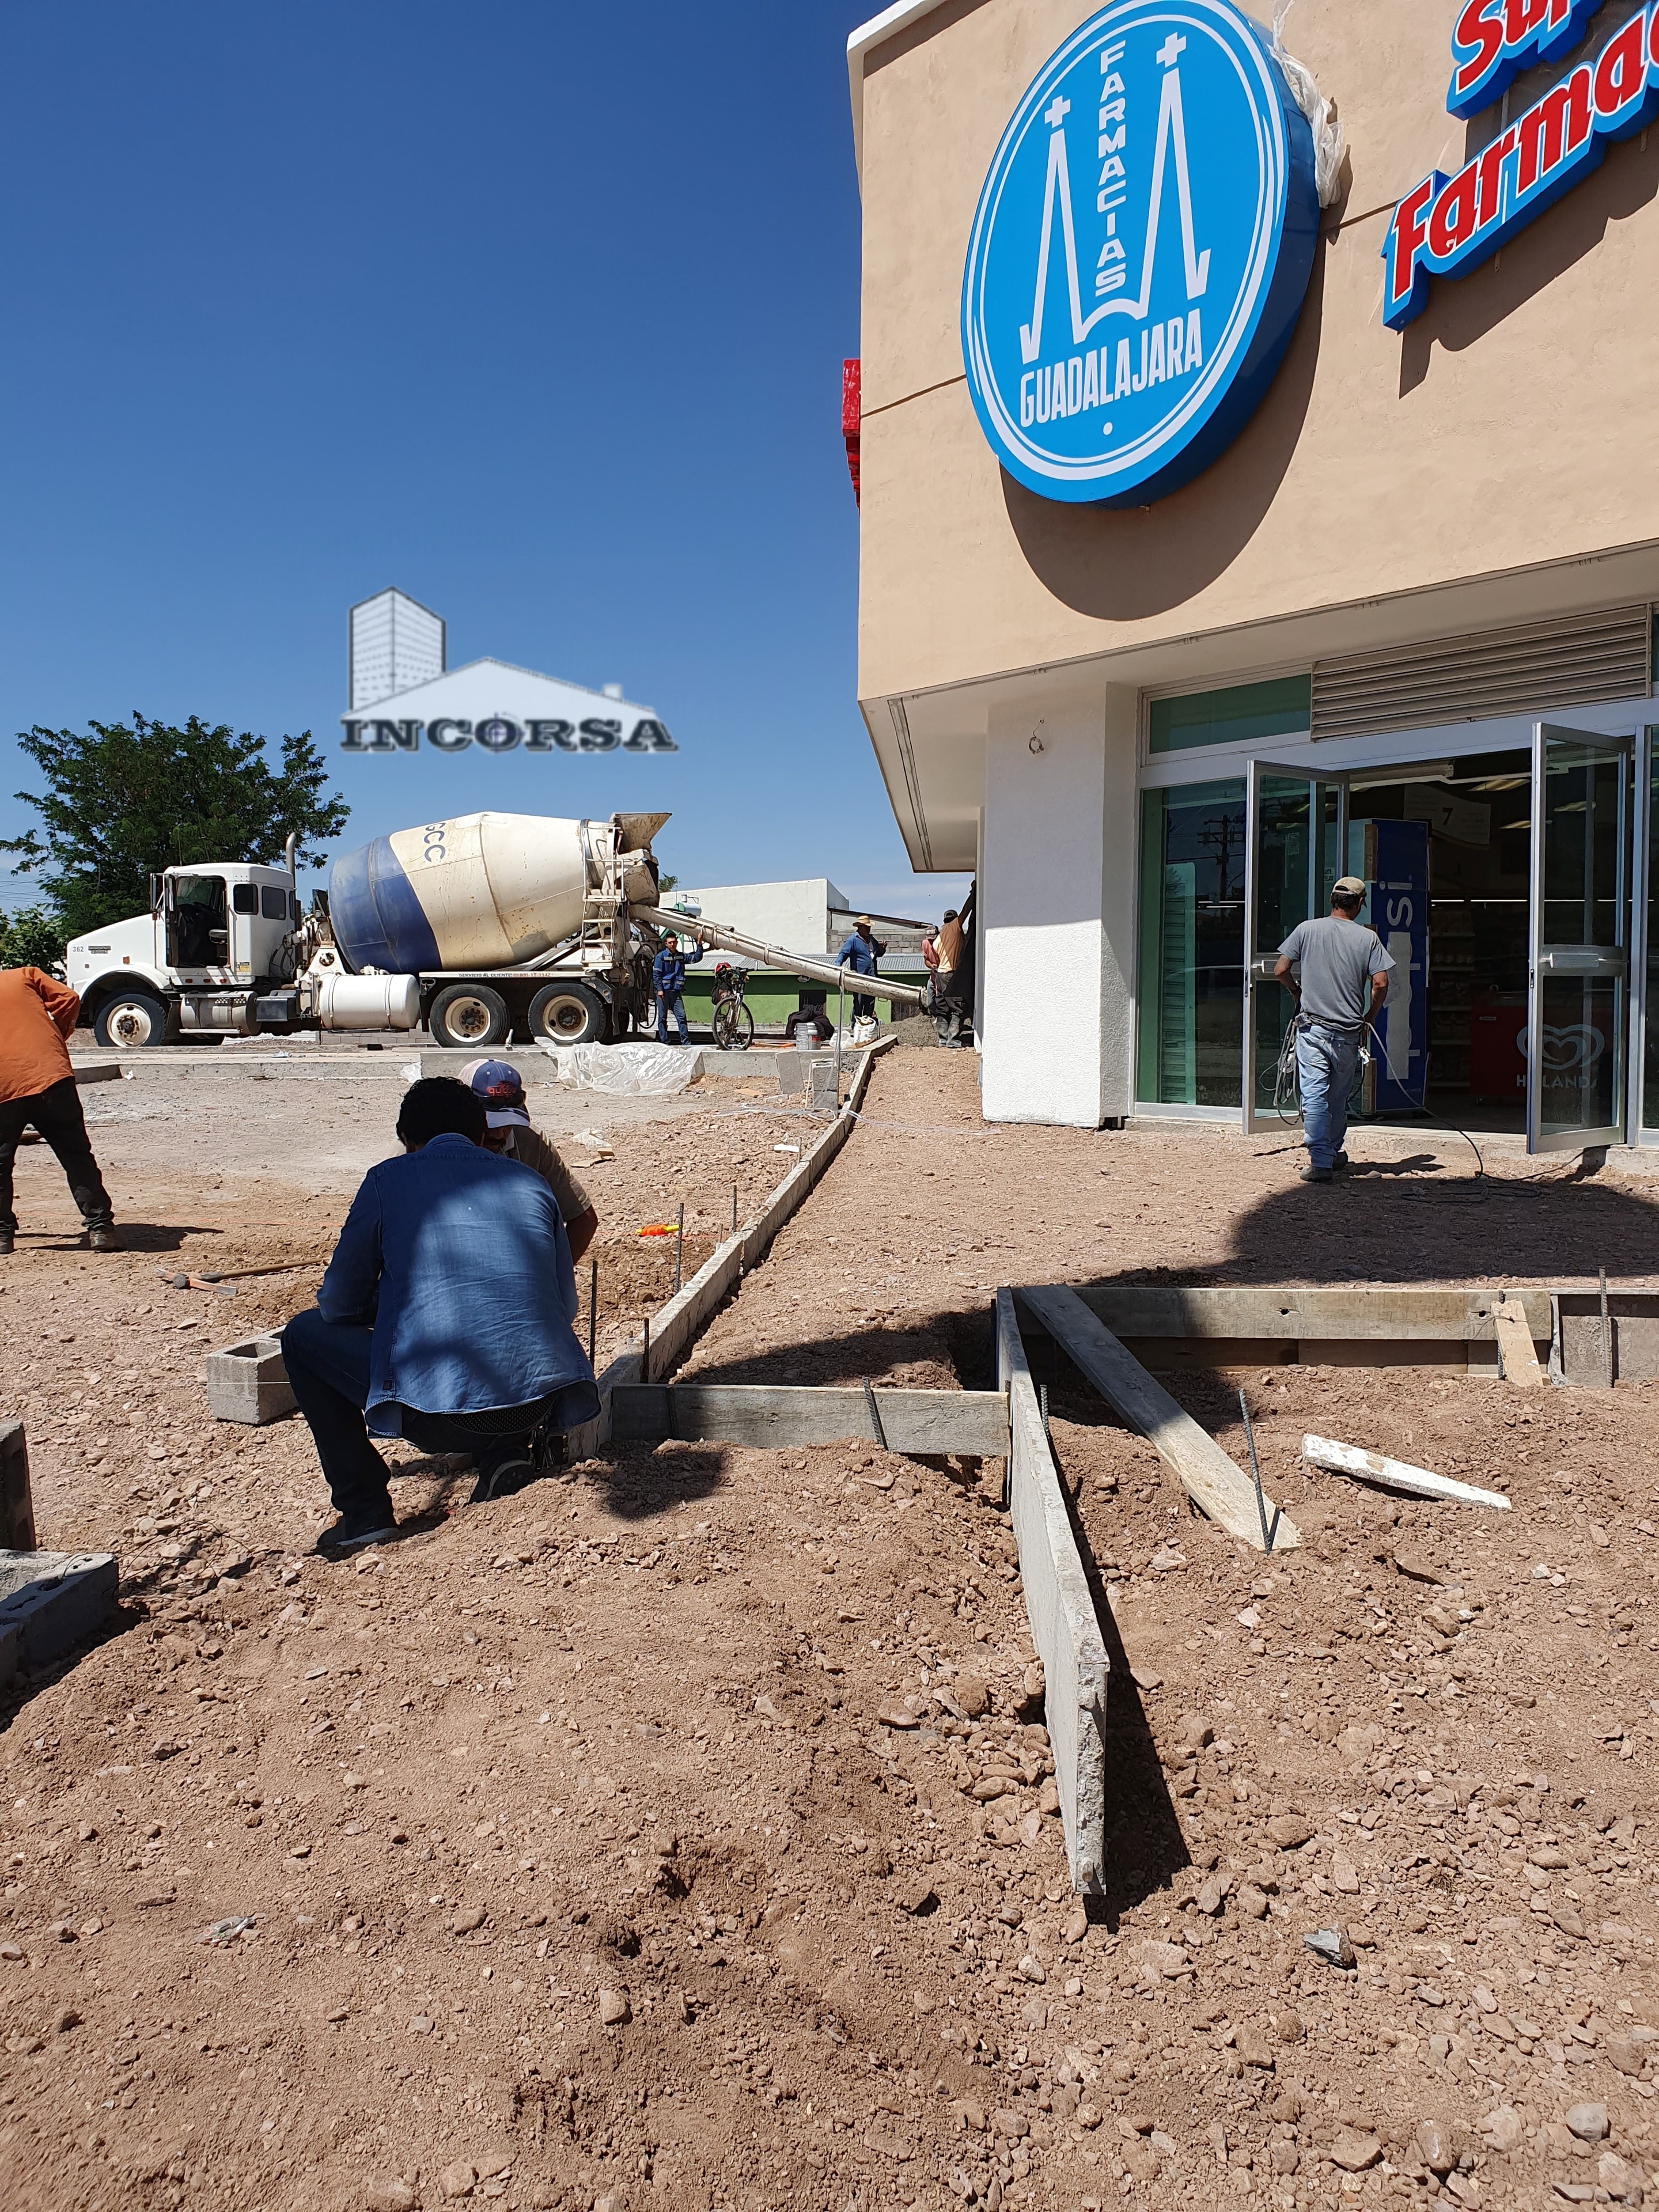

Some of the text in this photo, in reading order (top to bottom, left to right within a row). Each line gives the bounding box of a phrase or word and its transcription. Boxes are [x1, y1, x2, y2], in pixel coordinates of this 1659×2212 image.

[1095, 39, 1127, 297] FARMACIAS
[1020, 308, 1203, 428] GUADALAJARA
[1442, 806, 1453, 825] 7
[424, 823, 446, 862] GCC
[1516, 1074, 1597, 1089] HLAND
